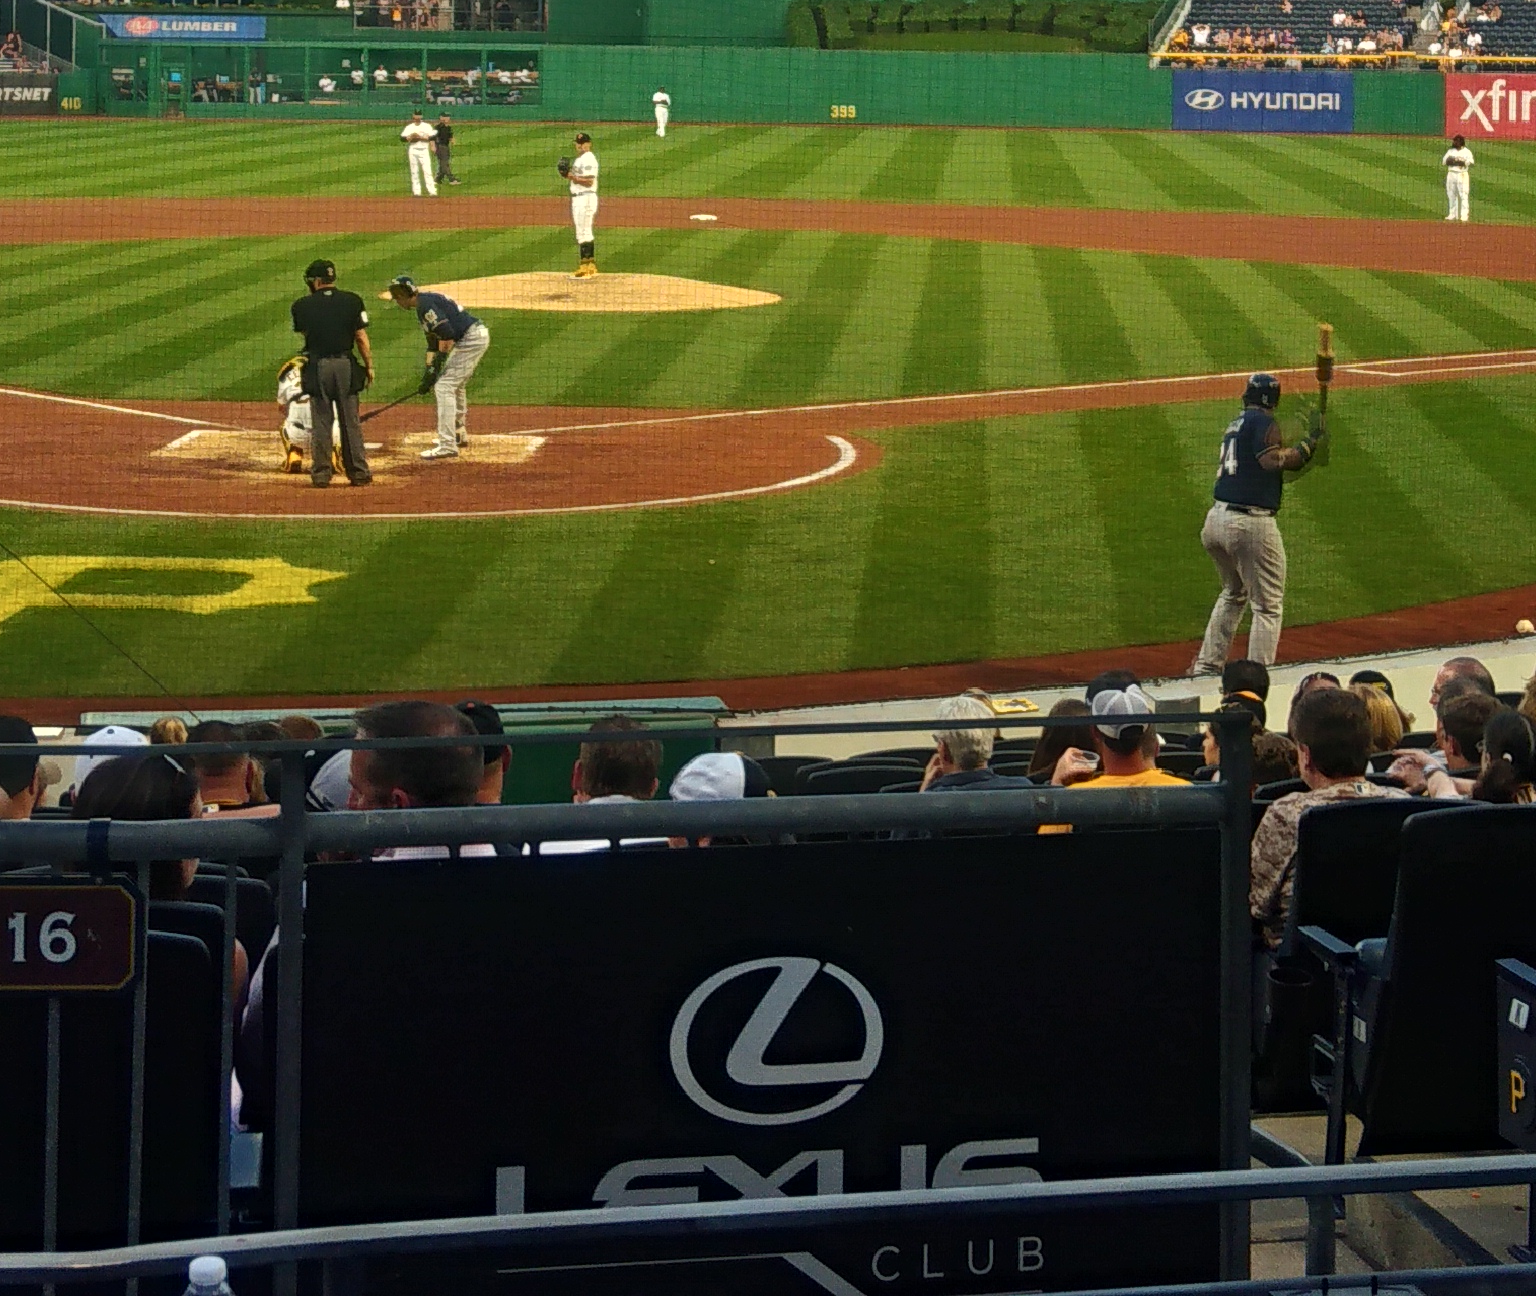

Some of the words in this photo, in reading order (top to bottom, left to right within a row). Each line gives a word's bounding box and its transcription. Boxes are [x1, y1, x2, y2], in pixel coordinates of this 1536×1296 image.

[161, 20, 238, 33] LUMBER
[830, 105, 857, 119] 399
[1231, 91, 1341, 112] HYUNDAI
[7, 911, 78, 964] 16
[1508, 1068, 1526, 1114] P
[870, 1235, 1046, 1283] CLUB
